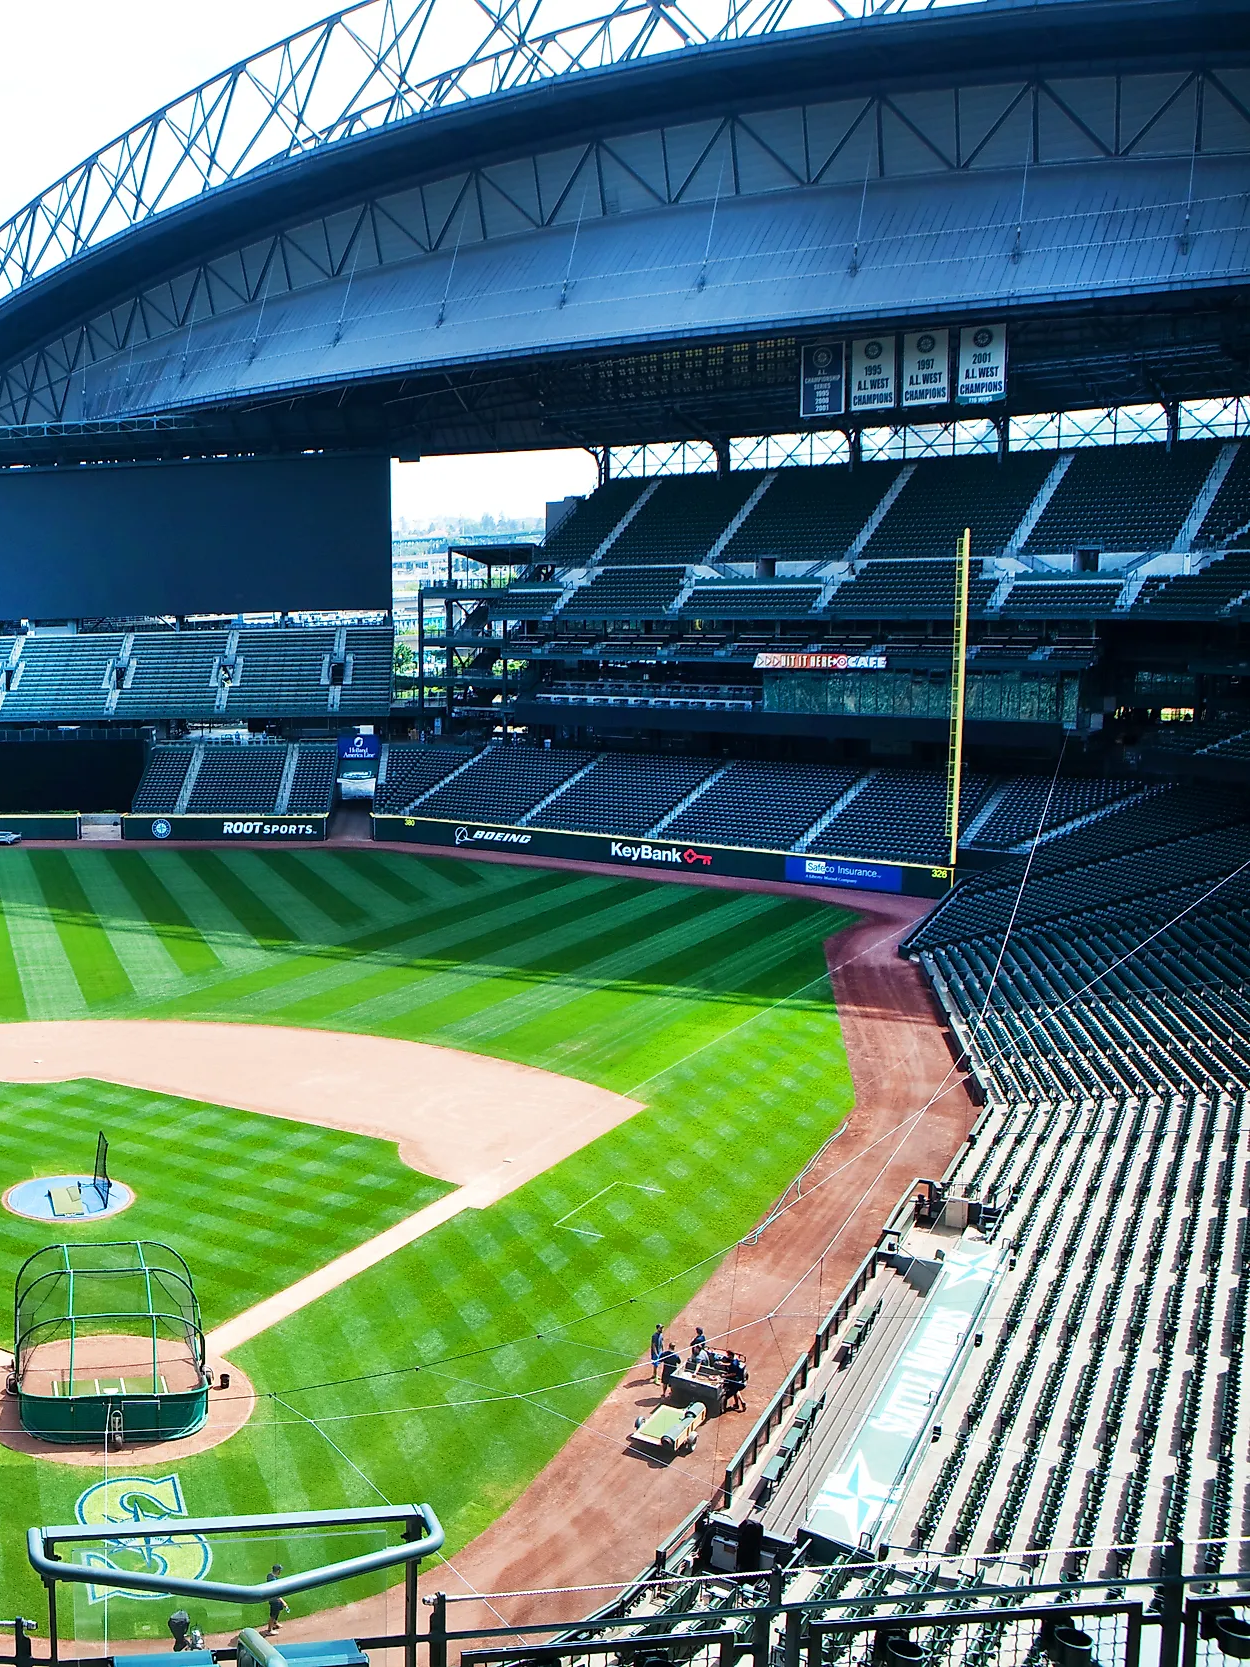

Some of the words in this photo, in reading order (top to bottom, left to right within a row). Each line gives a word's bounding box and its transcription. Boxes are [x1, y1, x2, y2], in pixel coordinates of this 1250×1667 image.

[918, 358, 934, 370] 1997
[972, 352, 991, 364] 2001
[864, 364, 882, 376] 1995
[978, 366, 999, 378] WEST
[804, 374, 840, 384] CHAMPIONSHIP
[870, 378, 890, 390] WEST
[922, 372, 942, 384] WEST
[960, 381, 1002, 394] CHAMPIONS
[853, 392, 892, 406] CHAMPIONS
[904, 387, 946, 401] CHAMPIONS
[781, 655, 796, 667] HIT
[798, 655, 808, 667] IT
[810, 656, 832, 668] HERE
[847, 656, 887, 668] CAFE
[223, 822, 264, 834] ROOT
[263, 824, 313, 834] SPORTS
[472, 830, 532, 844] BOEING
[610, 842, 682, 863] KeyBank
[808, 862, 834, 873] Safeco
[838, 866, 877, 878] Insurance
[932, 869, 948, 878] 326
